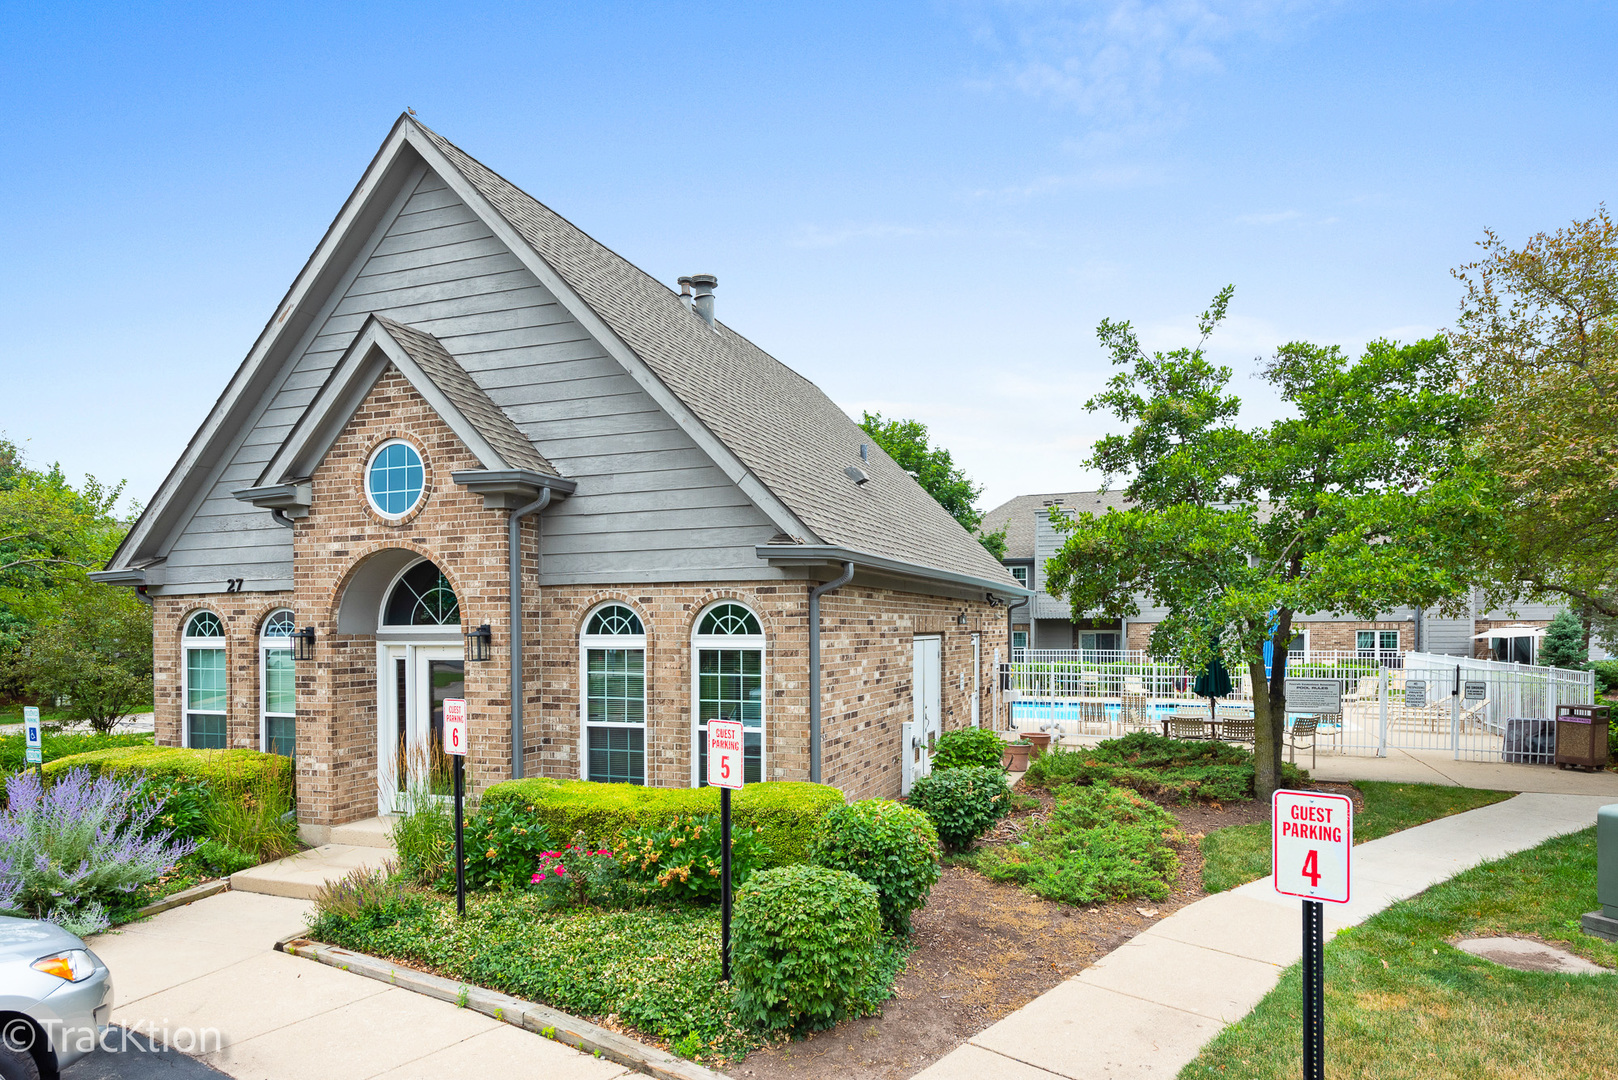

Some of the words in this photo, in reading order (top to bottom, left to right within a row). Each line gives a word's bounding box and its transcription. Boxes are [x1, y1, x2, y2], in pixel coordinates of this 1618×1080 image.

[226, 578, 244, 593] 27
[449, 706, 461, 714] GUEST
[446, 714, 464, 724] PARKING
[452, 728, 459, 748] 6
[716, 728, 735, 740] GUEST
[712, 738, 740, 751] PARKING
[720, 755, 730, 779] 5
[1290, 804, 1333, 824] GUEST
[1282, 822, 1342, 843] PARKING
[1302, 850, 1322, 888] 4
